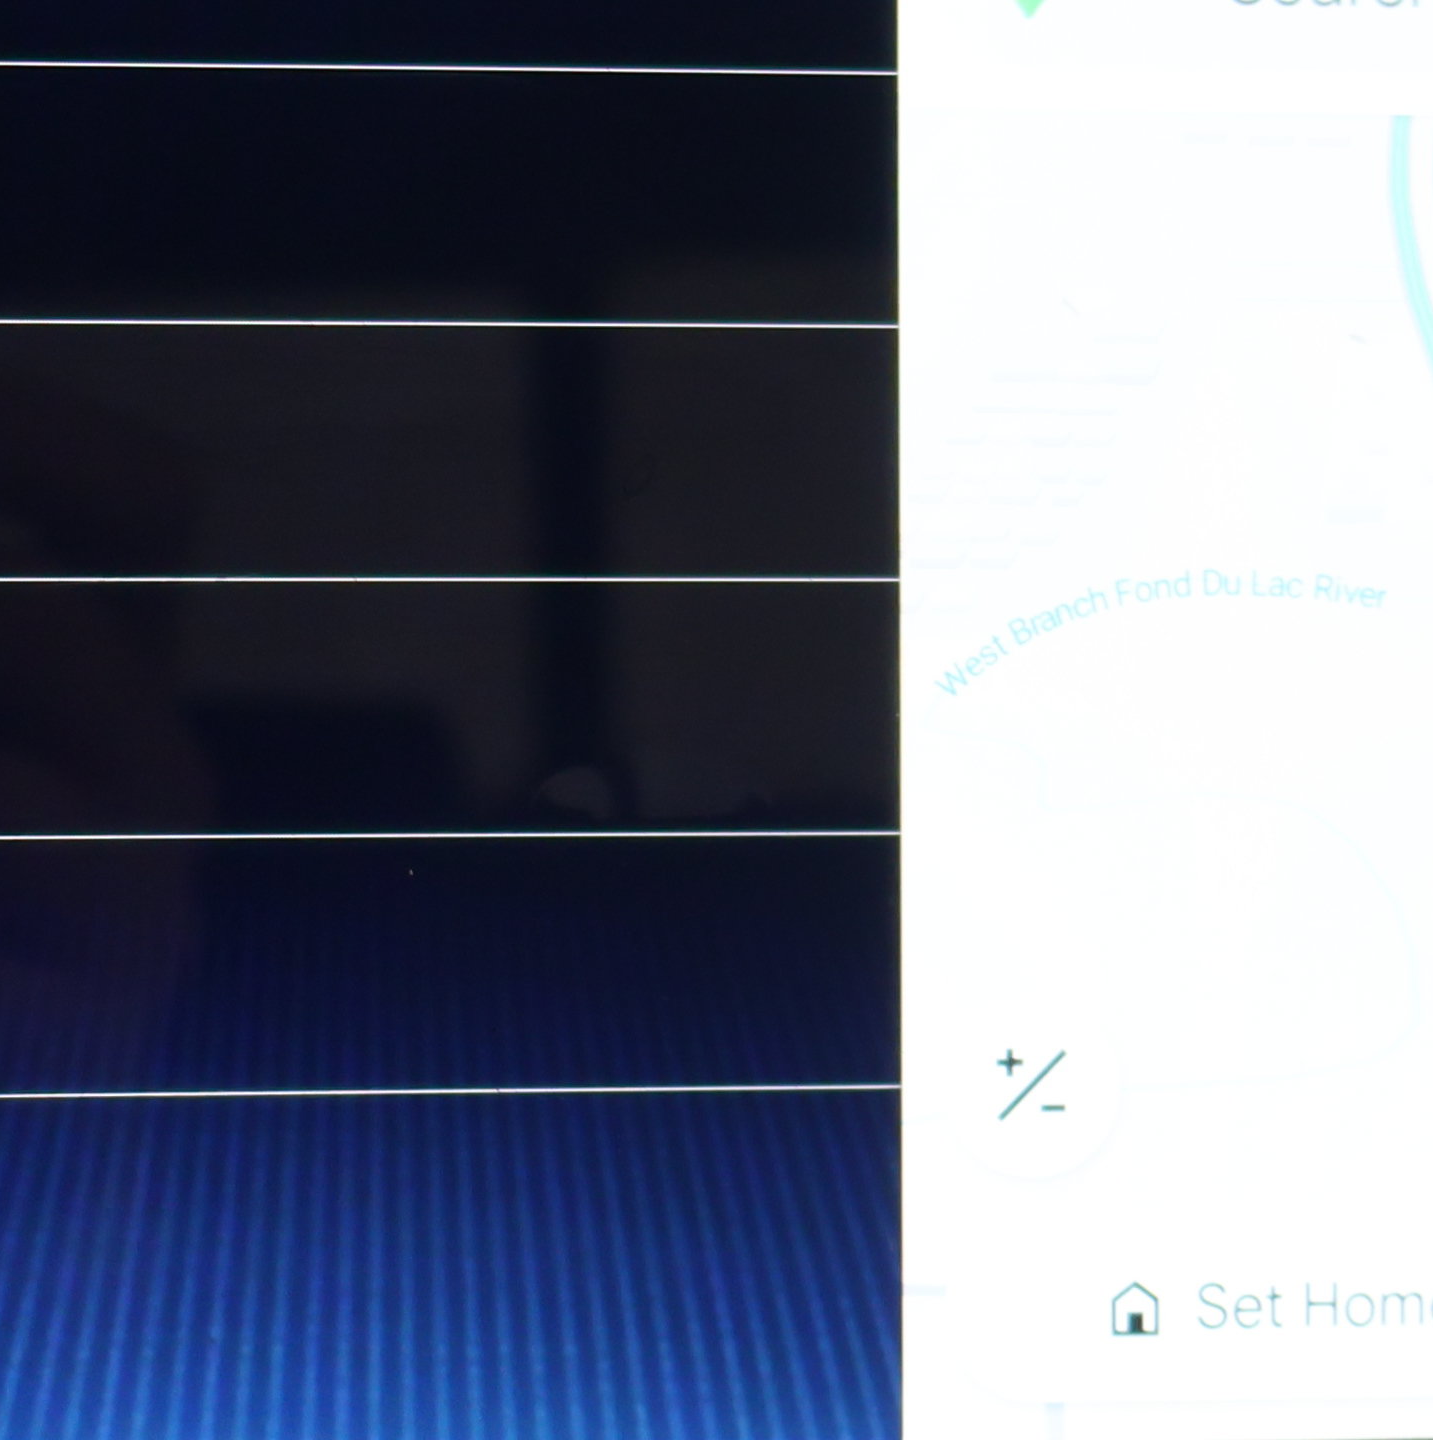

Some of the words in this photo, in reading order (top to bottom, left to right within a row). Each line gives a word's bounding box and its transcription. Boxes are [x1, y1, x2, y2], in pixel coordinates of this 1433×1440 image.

[933, 633, 1010, 699] West
[1008, 586, 1109, 647] Branch
[1114, 569, 1192, 607] Fond
[1202, 568, 1241, 596] Du
[1251, 570, 1303, 599] Lac
[1313, 573, 1388, 610] River
[1196, 1281, 1282, 1330] Set
